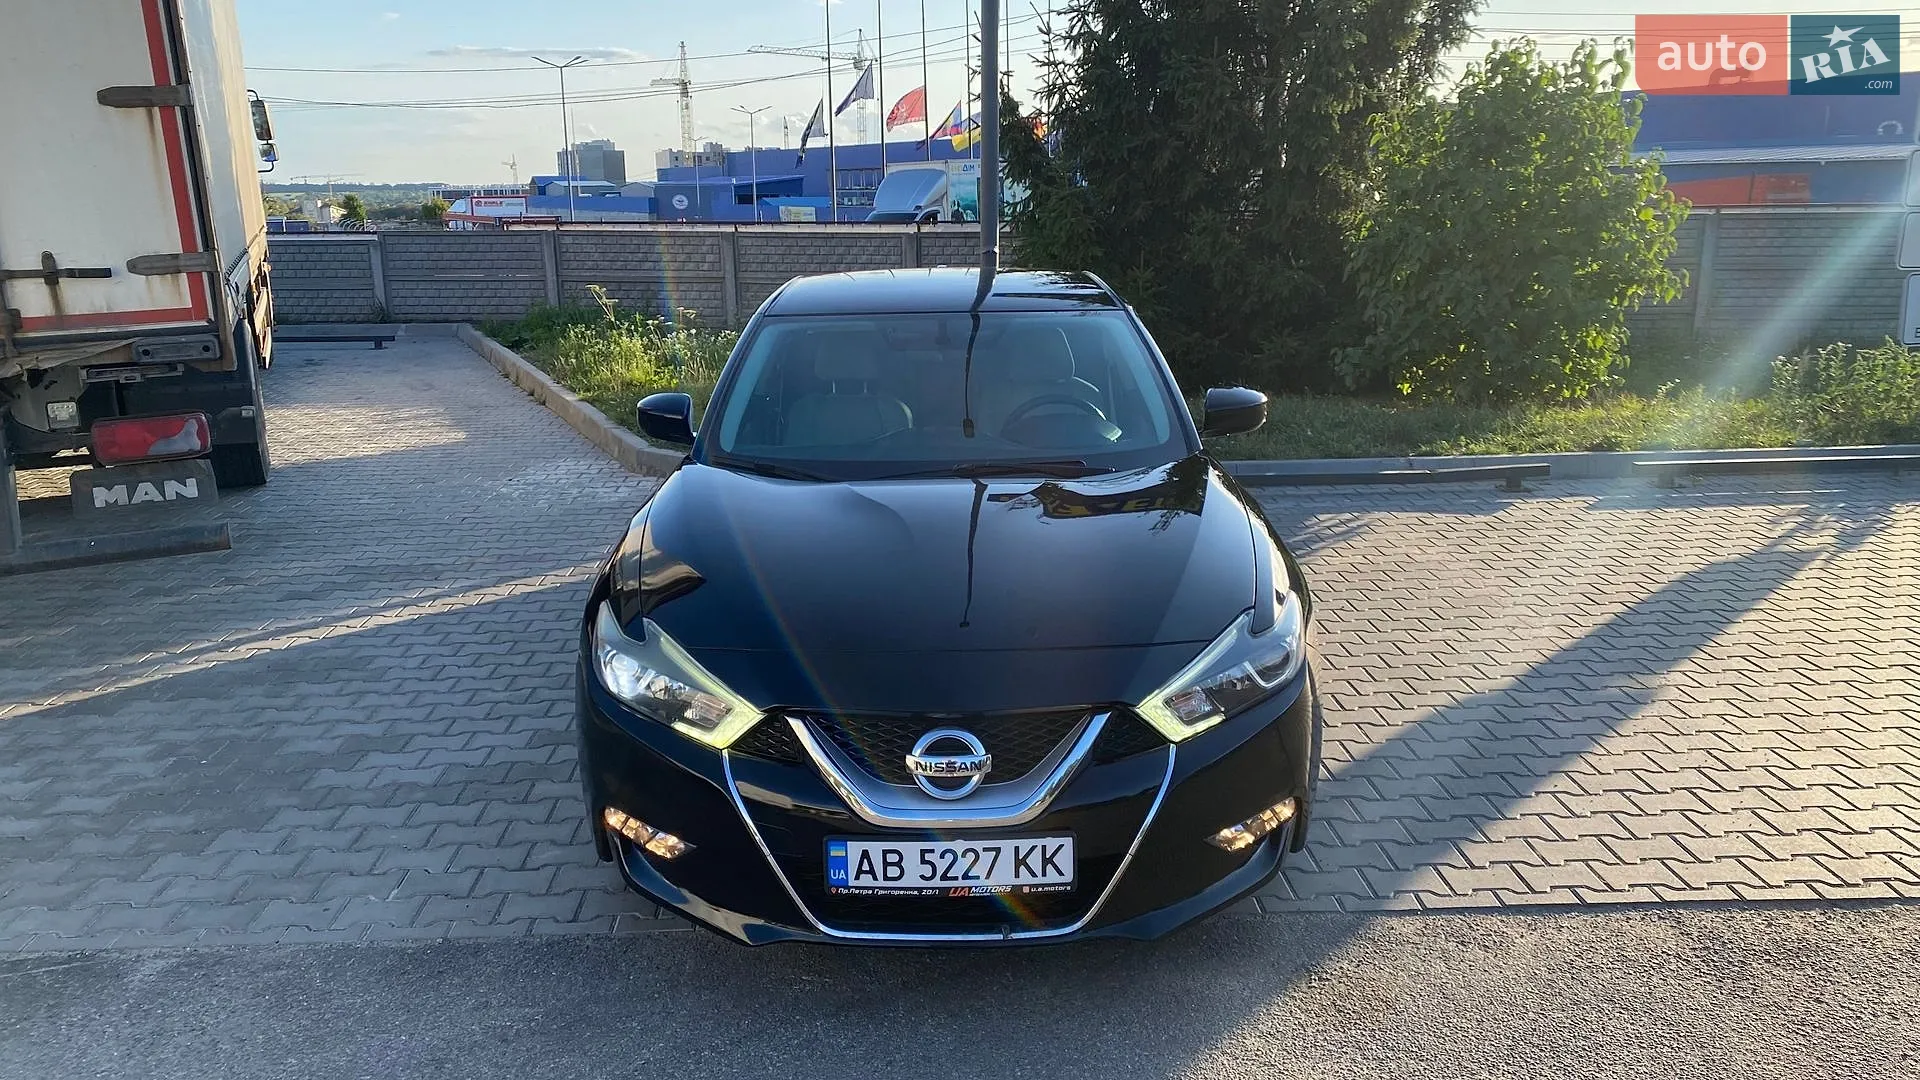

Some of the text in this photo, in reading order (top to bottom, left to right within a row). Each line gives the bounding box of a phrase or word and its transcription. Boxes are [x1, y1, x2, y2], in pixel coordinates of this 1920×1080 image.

[92, 478, 199, 508] MAN
[914, 759, 983, 773] NISSAN
[853, 843, 1065, 882] AB 5227 KK
[830, 869, 847, 880] UA
[970, 885, 1012, 893] MOTORS
